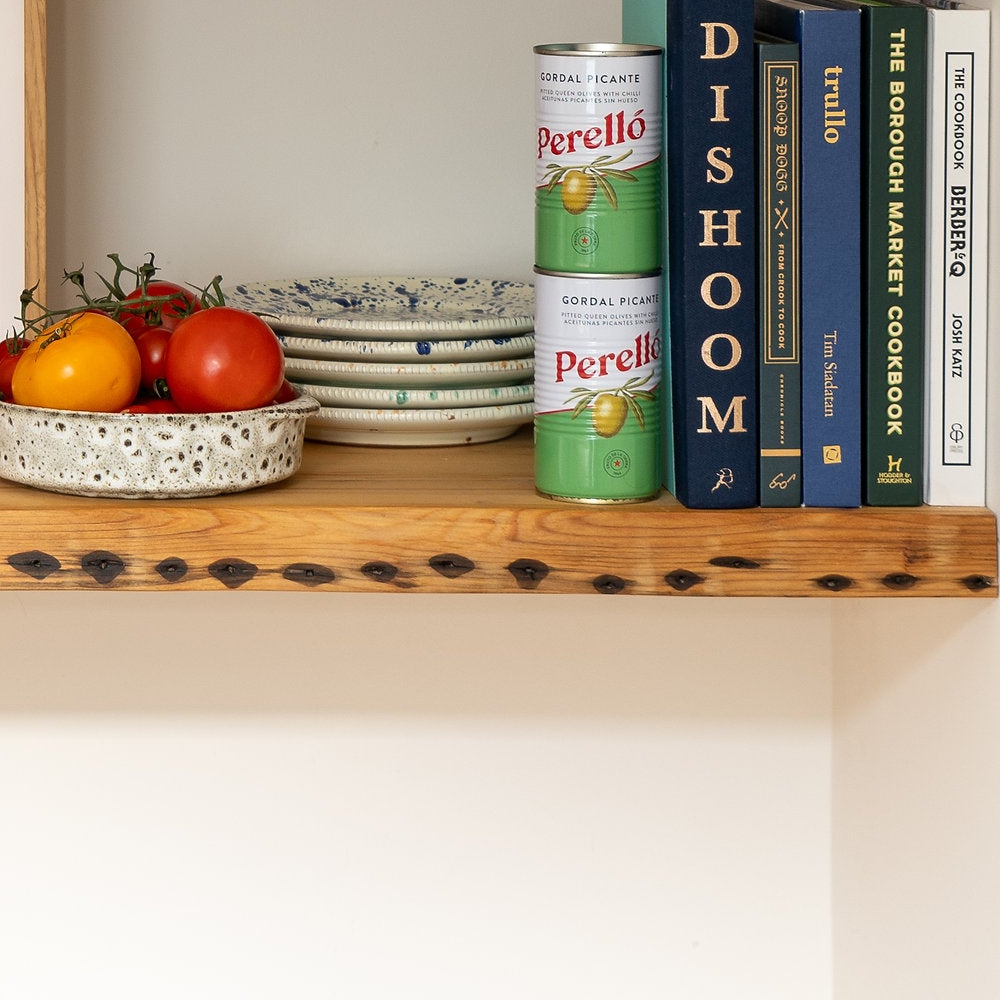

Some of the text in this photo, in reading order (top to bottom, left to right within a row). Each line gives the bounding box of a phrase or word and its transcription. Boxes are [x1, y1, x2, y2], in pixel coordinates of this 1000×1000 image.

[540, 72, 640, 84] GORDAL PICANTE
[824, 65, 847, 144] trullo
[954, 67, 965, 89] THE
[537, 109, 646, 159] Perelló
[953, 93, 965, 170] COOKBOOK
[887, 28, 905, 436] THE BOROUGH MARKET COOKBOOK
[562, 294, 659, 306] GORDAL PICANTE
[778, 308, 785, 320] TO
[824, 330, 839, 417] Tim Siadatan
[952, 313, 963, 378] JOSH KATZ
